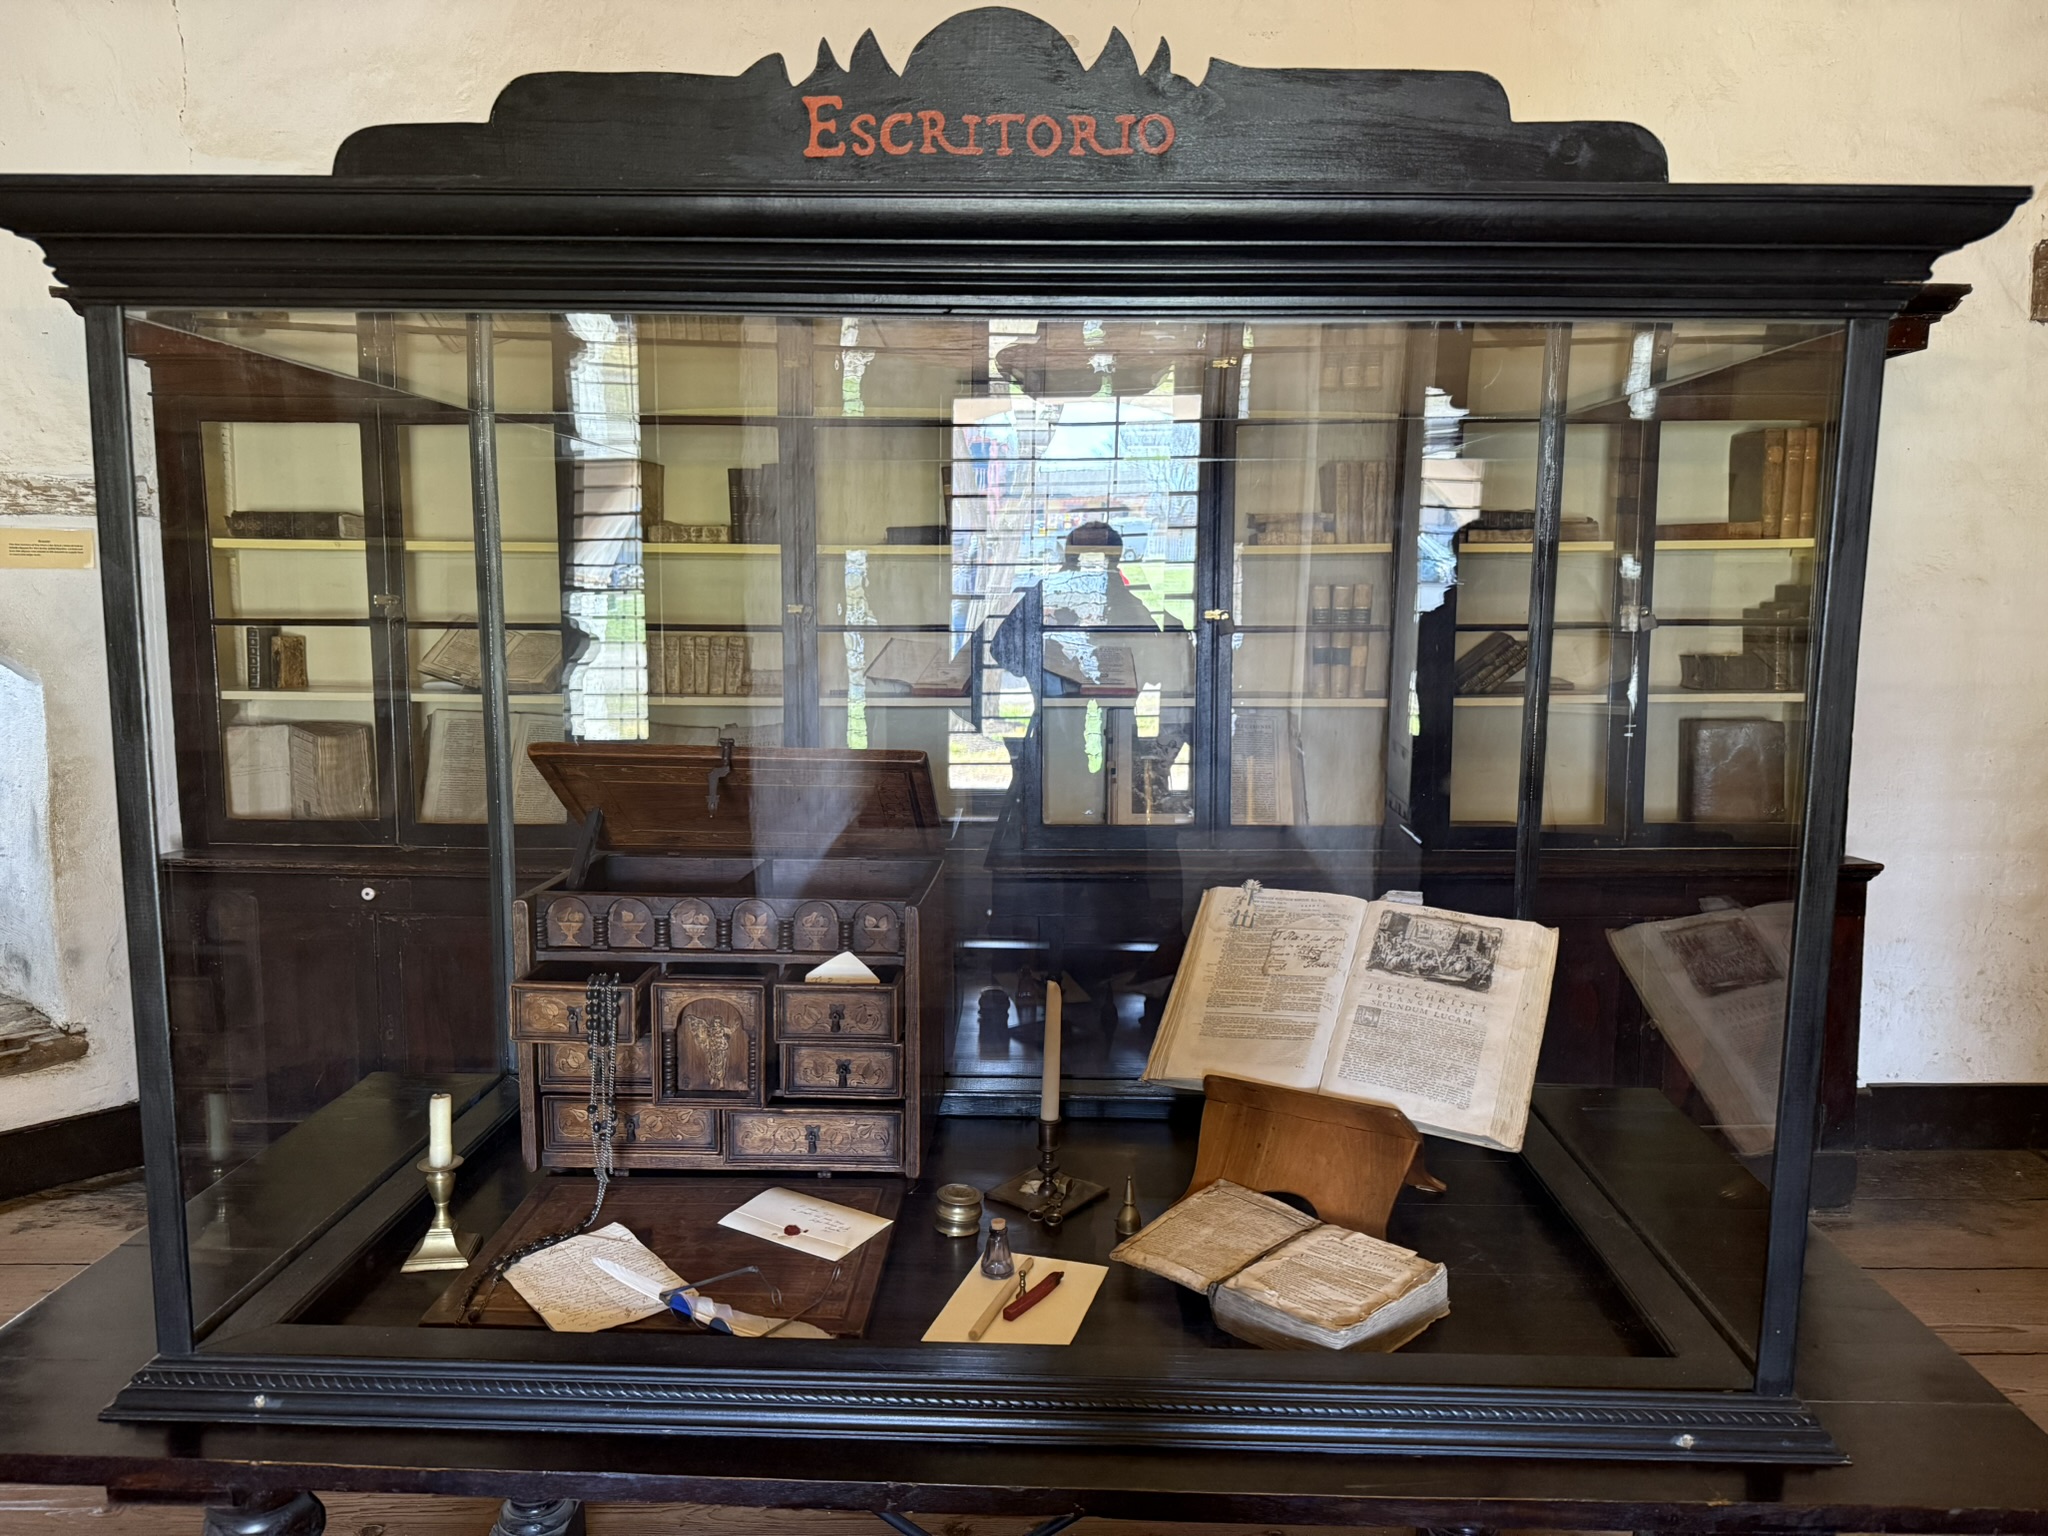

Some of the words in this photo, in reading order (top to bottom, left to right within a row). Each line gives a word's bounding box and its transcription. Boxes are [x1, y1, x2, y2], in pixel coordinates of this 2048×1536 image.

[802, 95, 1175, 158] ESCRITORIO
[1367, 983, 1404, 995] JESU
[1414, 991, 1487, 1012] CHRISTI
[1371, 1000, 1428, 1015] SECUNDUM
[1377, 993, 1473, 1017] EVANGELIUM
